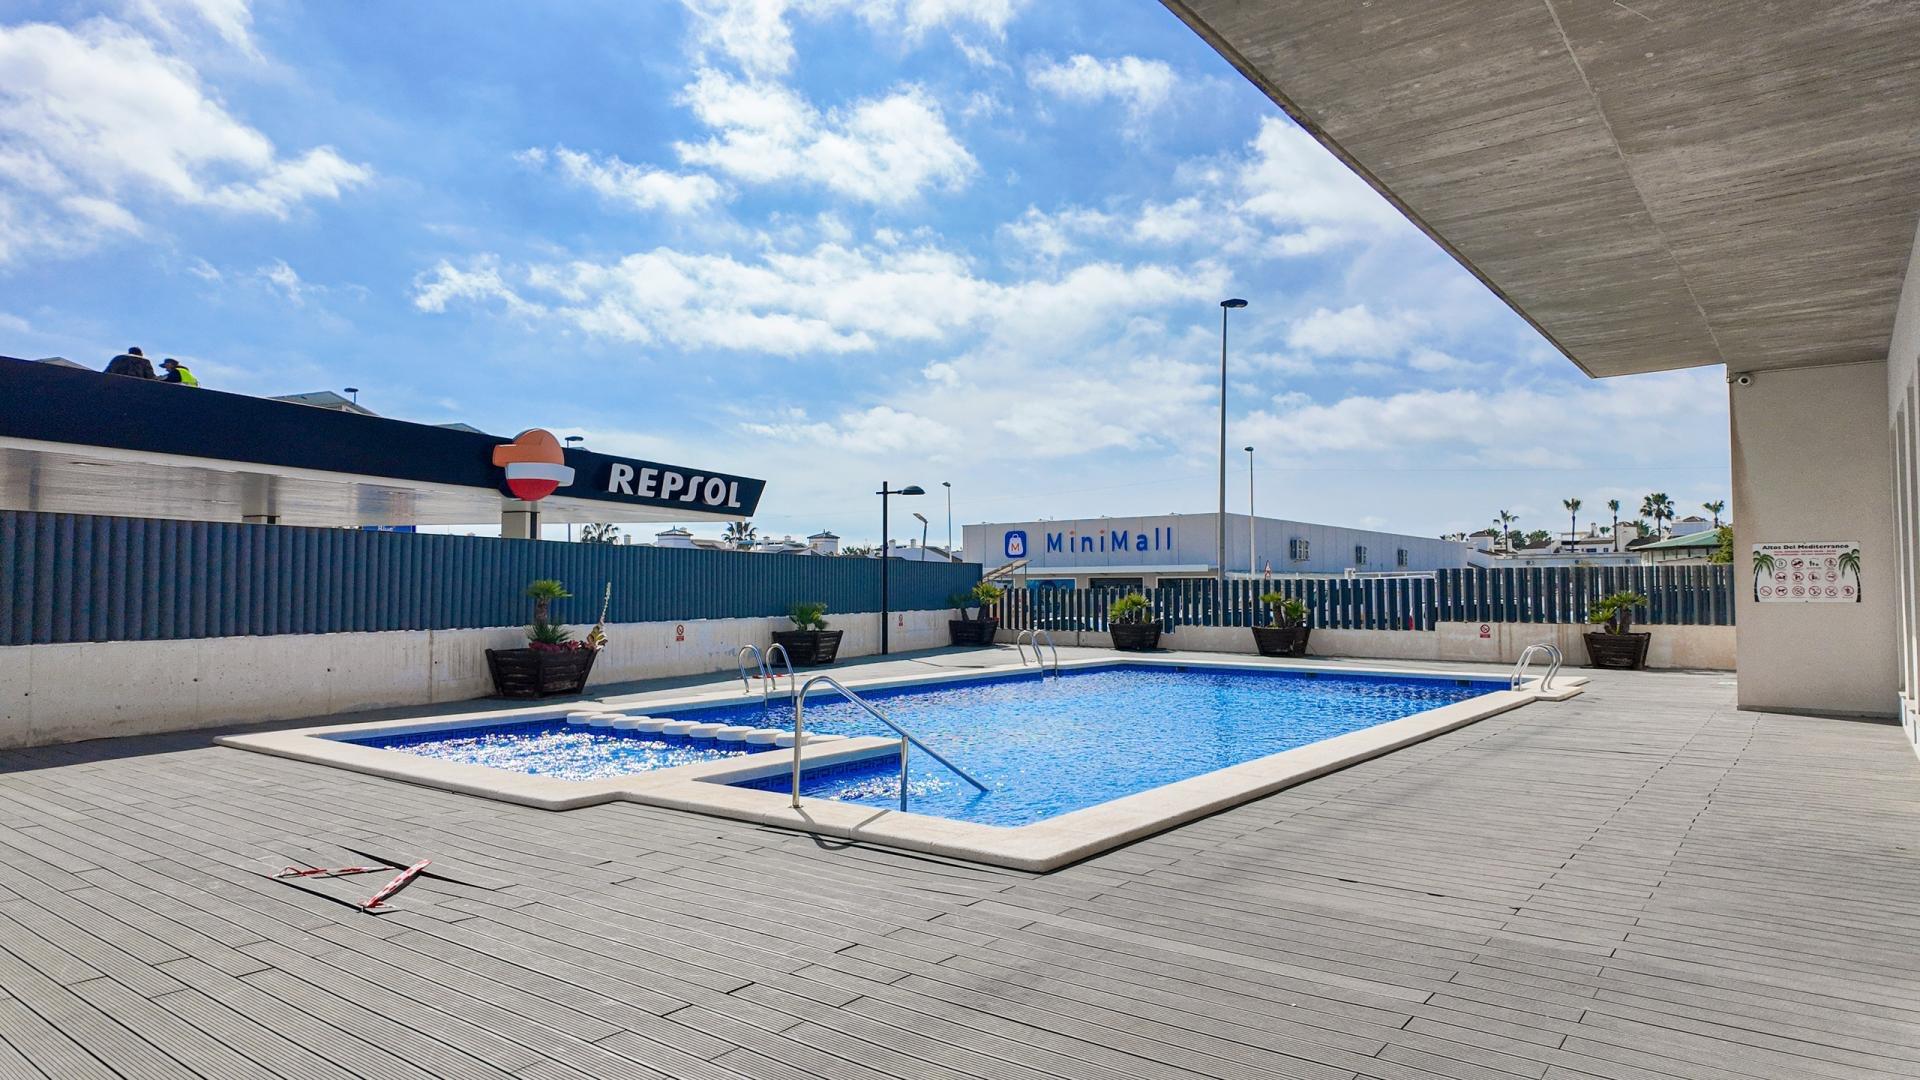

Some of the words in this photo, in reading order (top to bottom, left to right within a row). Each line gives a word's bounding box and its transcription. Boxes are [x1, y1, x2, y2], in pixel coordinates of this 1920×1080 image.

[608, 463, 741, 508] REPSOL
[1011, 543, 1020, 551] M
[1047, 527, 1171, 553] MiniMall
